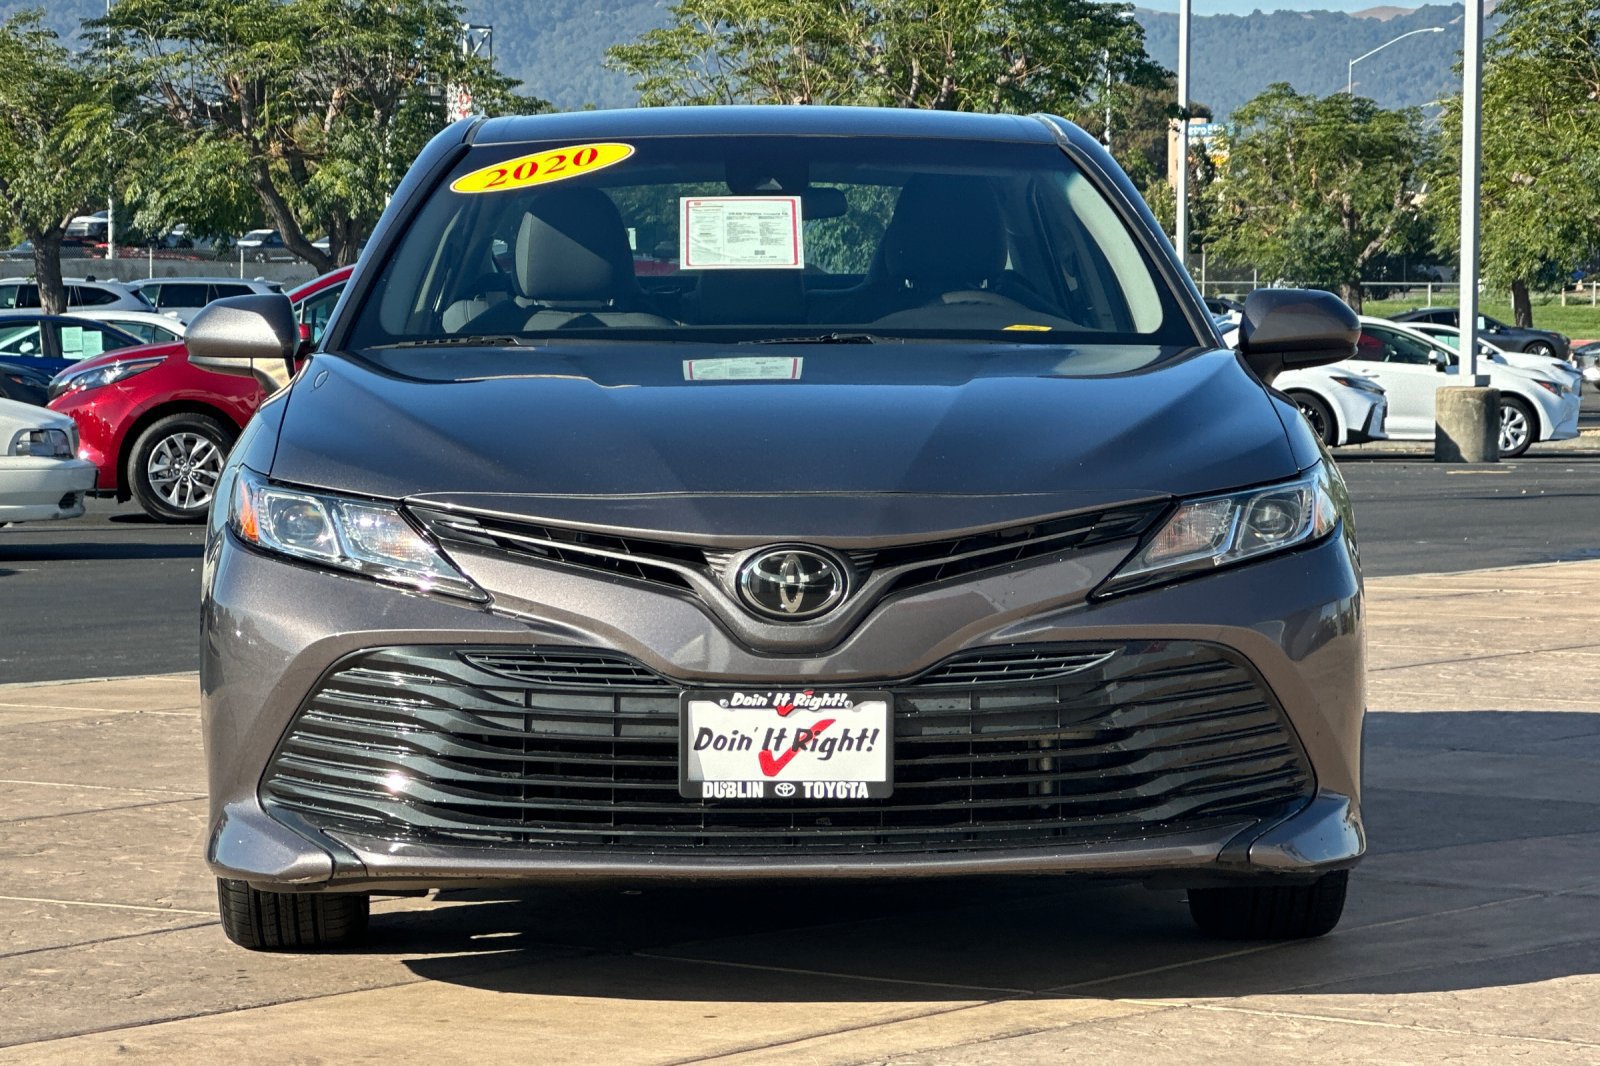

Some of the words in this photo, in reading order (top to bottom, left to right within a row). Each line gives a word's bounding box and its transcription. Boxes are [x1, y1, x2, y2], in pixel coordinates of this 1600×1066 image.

[484, 147, 598, 188] 2020
[730, 692, 772, 706] Doin'
[773, 693, 791, 706] It
[793, 692, 848, 710] Right!
[693, 726, 758, 751] Doin'
[761, 727, 788, 752] It
[792, 728, 880, 760] Right!
[702, 781, 764, 798] DUBLIN
[802, 781, 869, 798] TOYOTA
